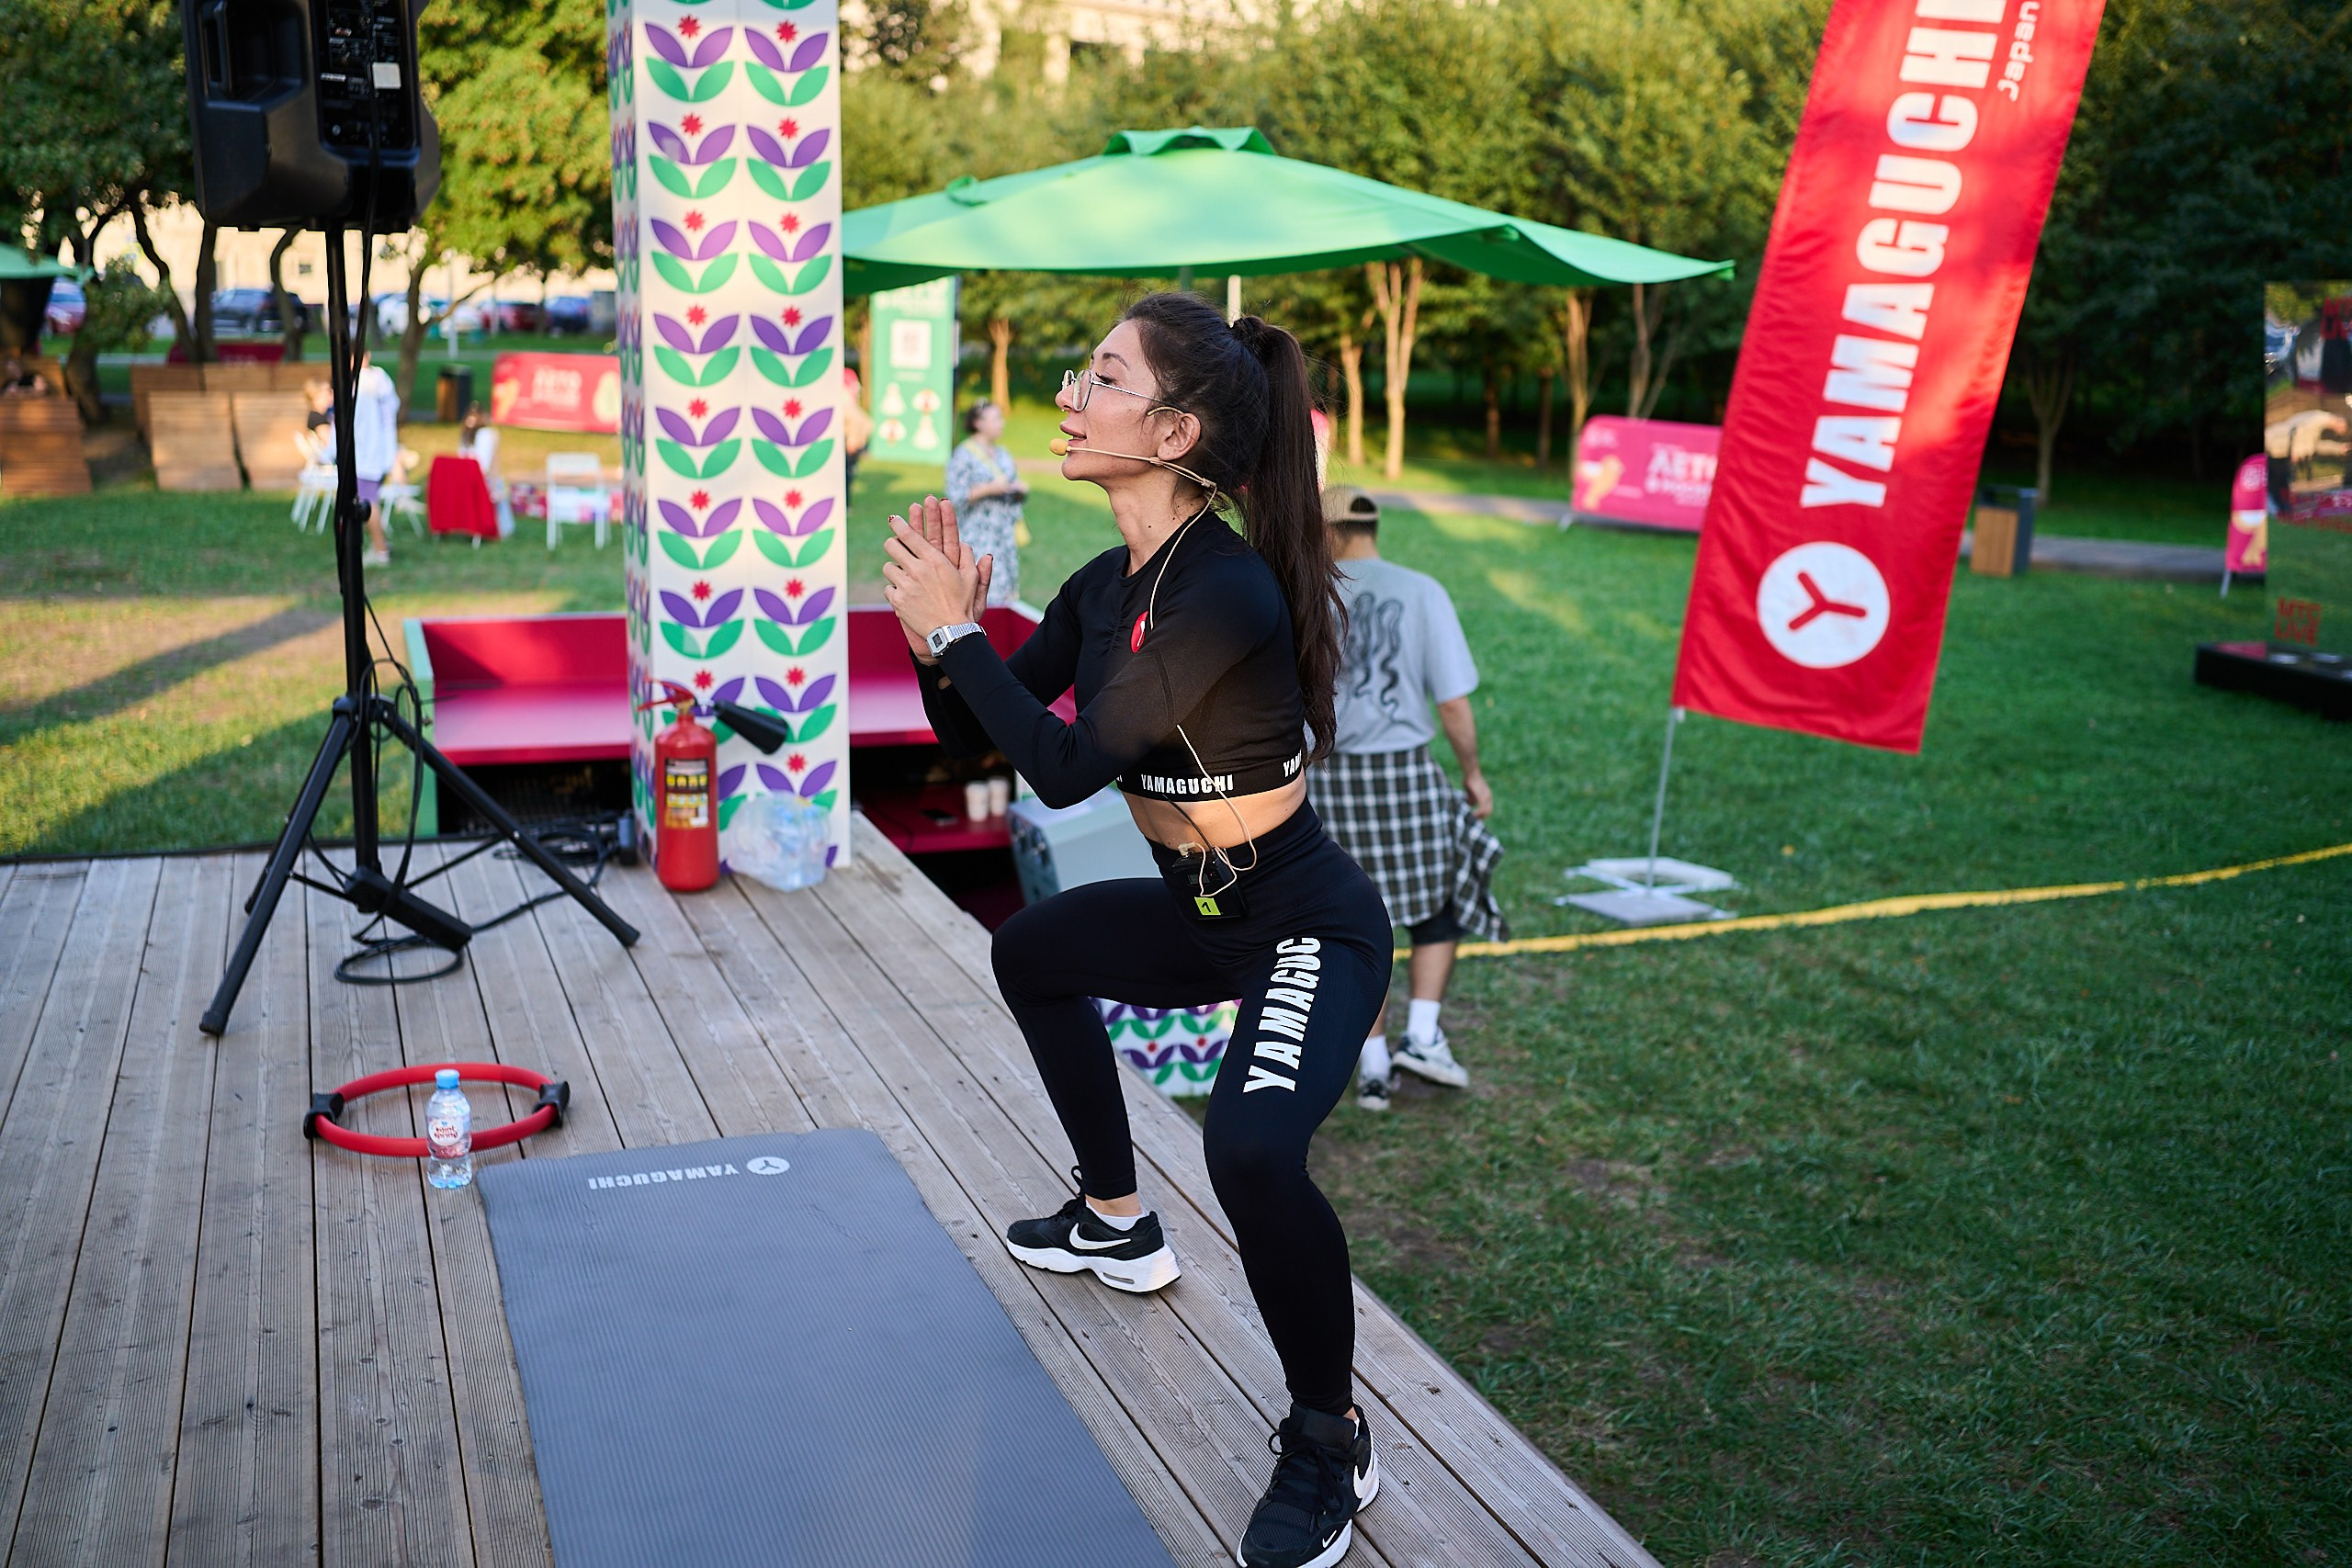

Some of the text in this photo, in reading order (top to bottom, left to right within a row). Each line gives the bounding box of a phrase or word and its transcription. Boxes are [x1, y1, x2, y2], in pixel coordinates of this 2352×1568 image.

[1996, 1, 2041, 102] Japan
[1800, 0, 2007, 507] YAMAGUCHI
[1140, 773, 1234, 795] YAMAGUCHI
[1201, 901, 1212, 913] 1
[587, 1163, 741, 1190] YAMAGUCHI
